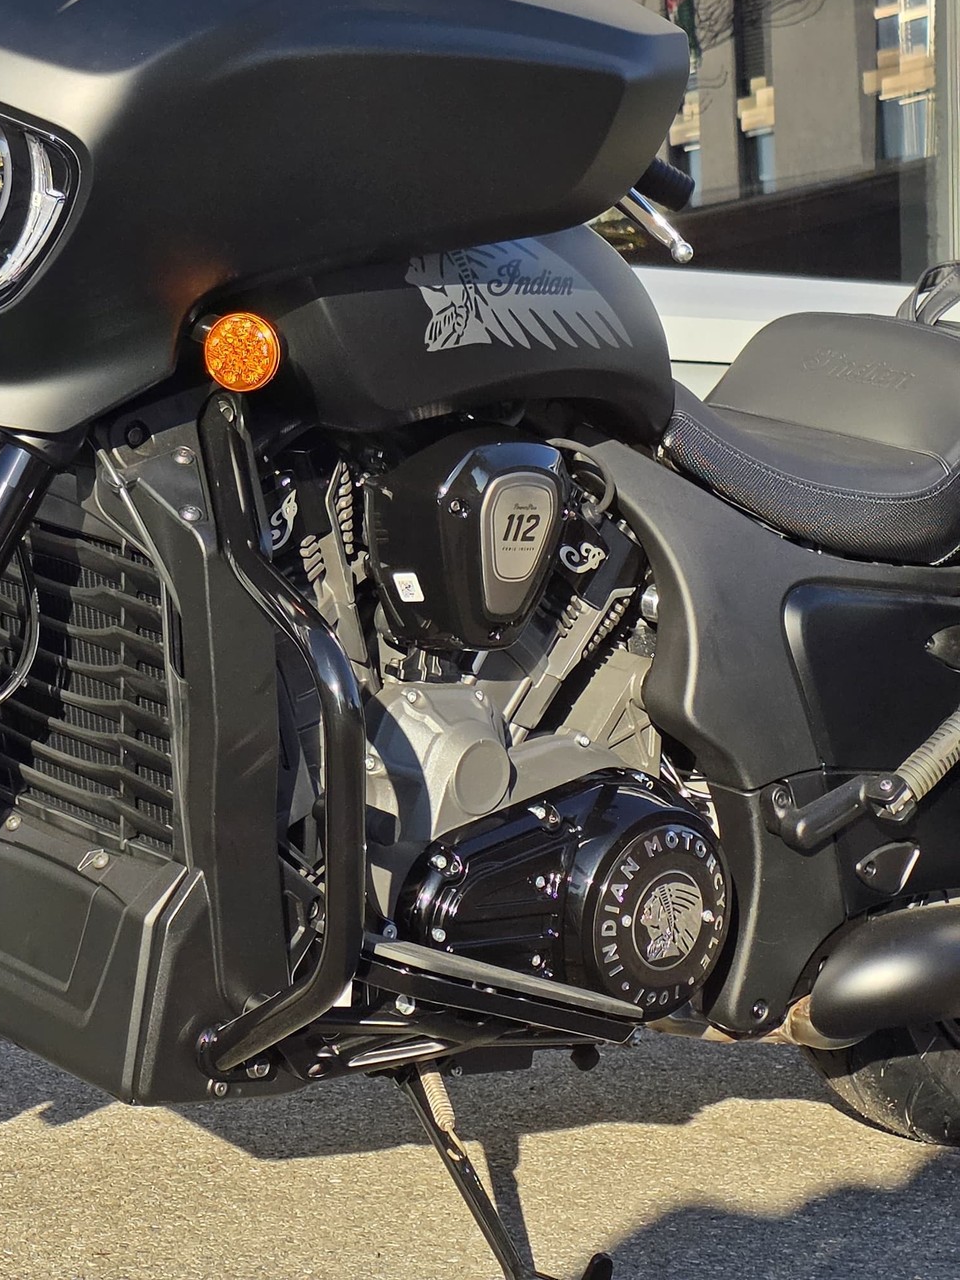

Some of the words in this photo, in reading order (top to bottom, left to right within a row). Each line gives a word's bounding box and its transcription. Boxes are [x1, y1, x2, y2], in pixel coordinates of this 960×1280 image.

[487, 259, 574, 297] Indian
[502, 513, 541, 542] 112
[601, 856, 641, 978] INDIAN
[644, 831, 726, 970] MOTORCYCLE
[633, 984, 680, 1006] 1901
